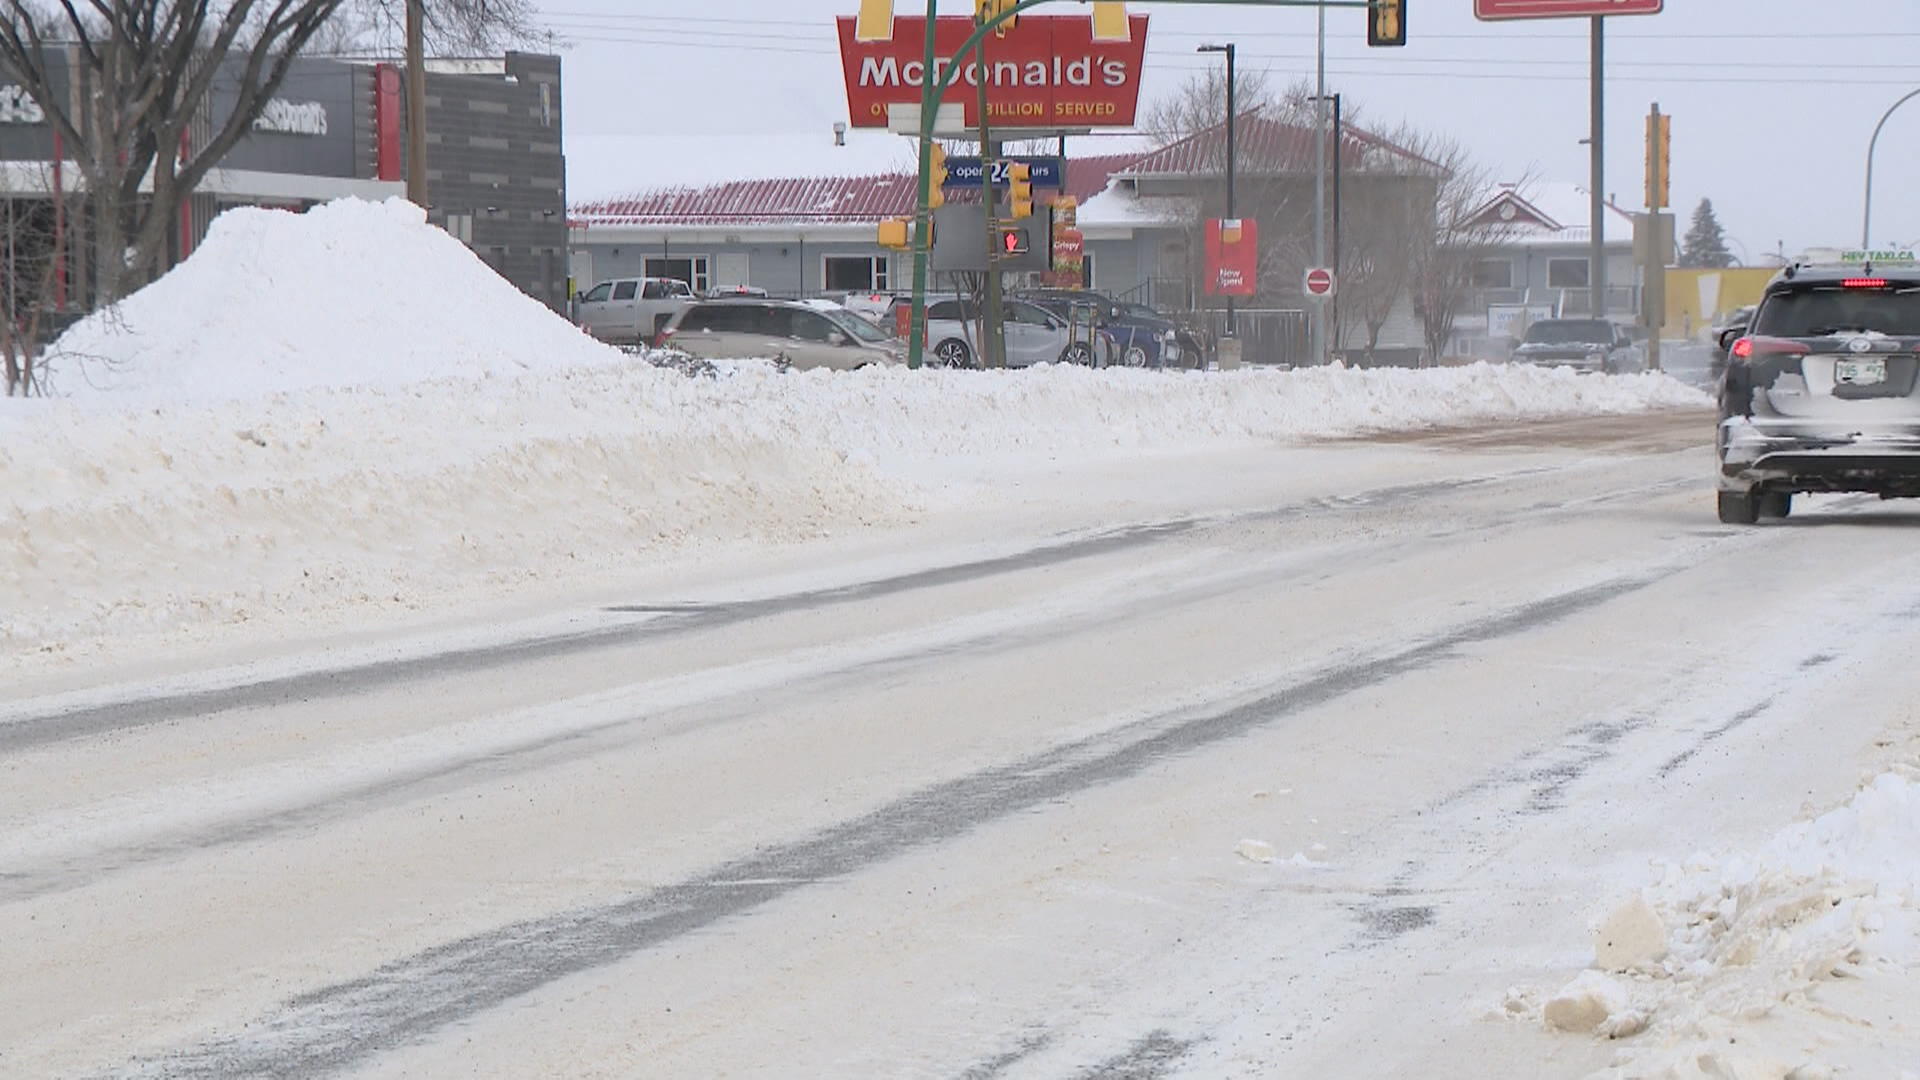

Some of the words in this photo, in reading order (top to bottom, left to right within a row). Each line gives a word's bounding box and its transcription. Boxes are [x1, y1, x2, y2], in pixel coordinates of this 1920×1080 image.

[859, 56, 1127, 87] McDonald's
[1055, 103, 1115, 115] SERVED
[1053, 241, 1080, 251] Crispy
